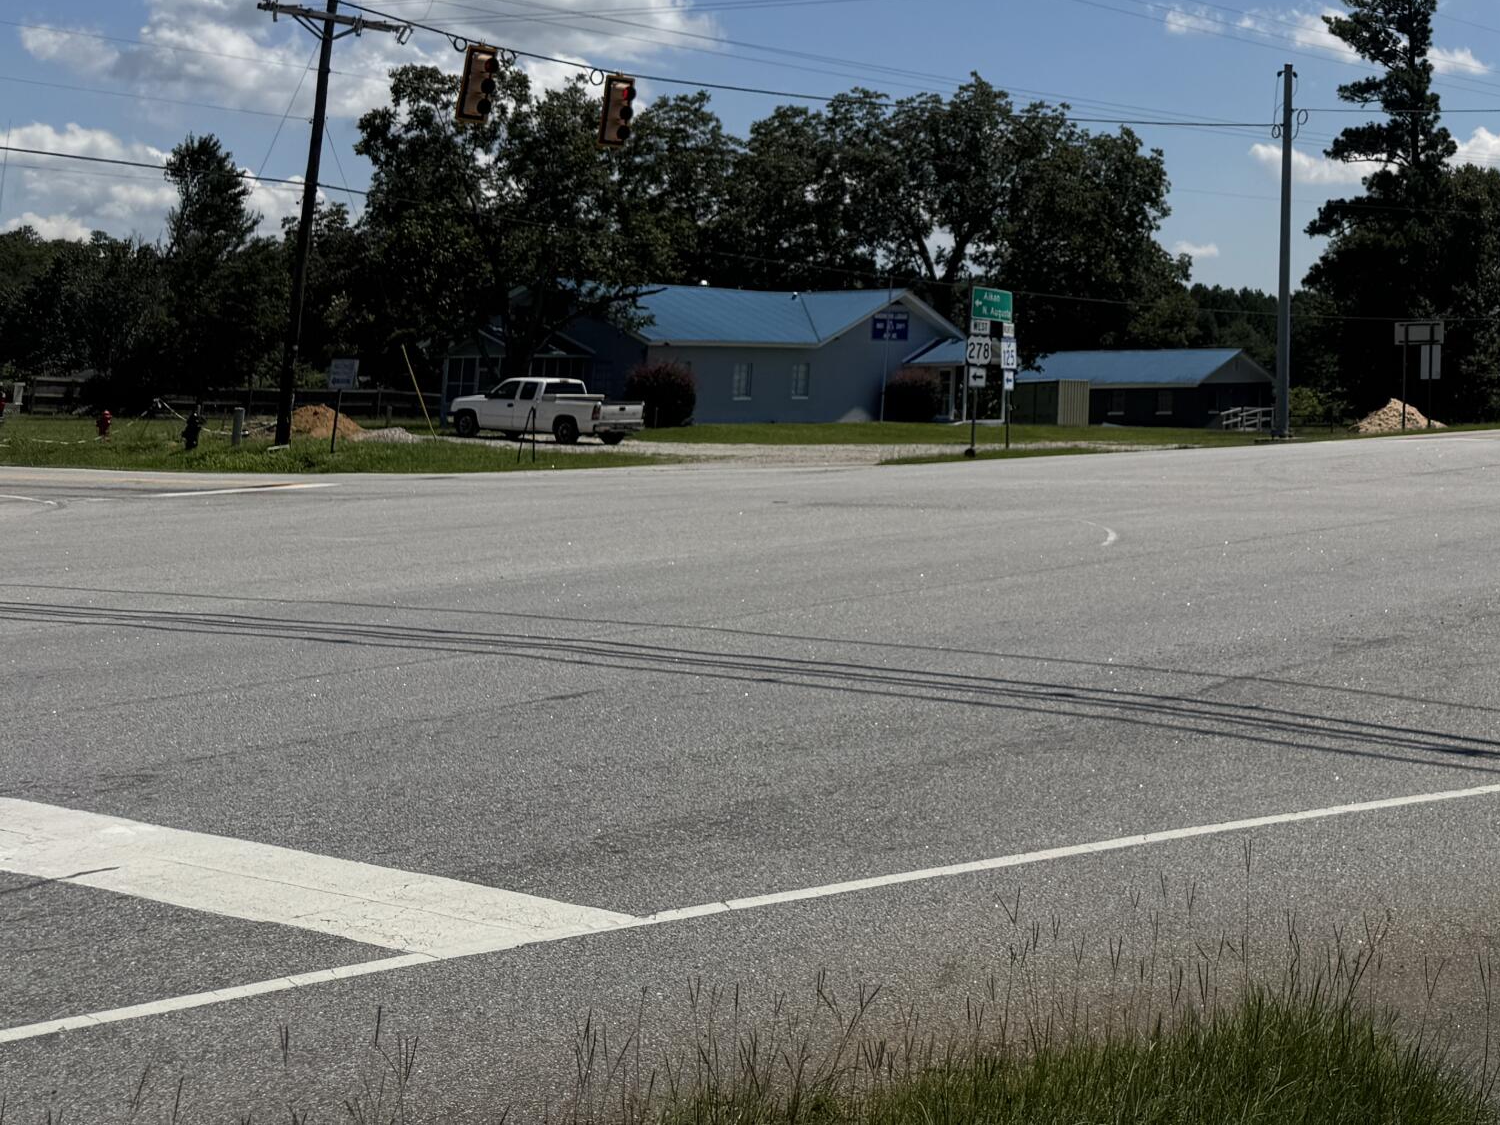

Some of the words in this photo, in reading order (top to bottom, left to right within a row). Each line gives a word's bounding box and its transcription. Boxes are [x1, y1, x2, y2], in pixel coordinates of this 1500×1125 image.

[973, 321, 988, 331] WEST
[968, 342, 990, 359] 278
[1003, 349, 1015, 366] 125
